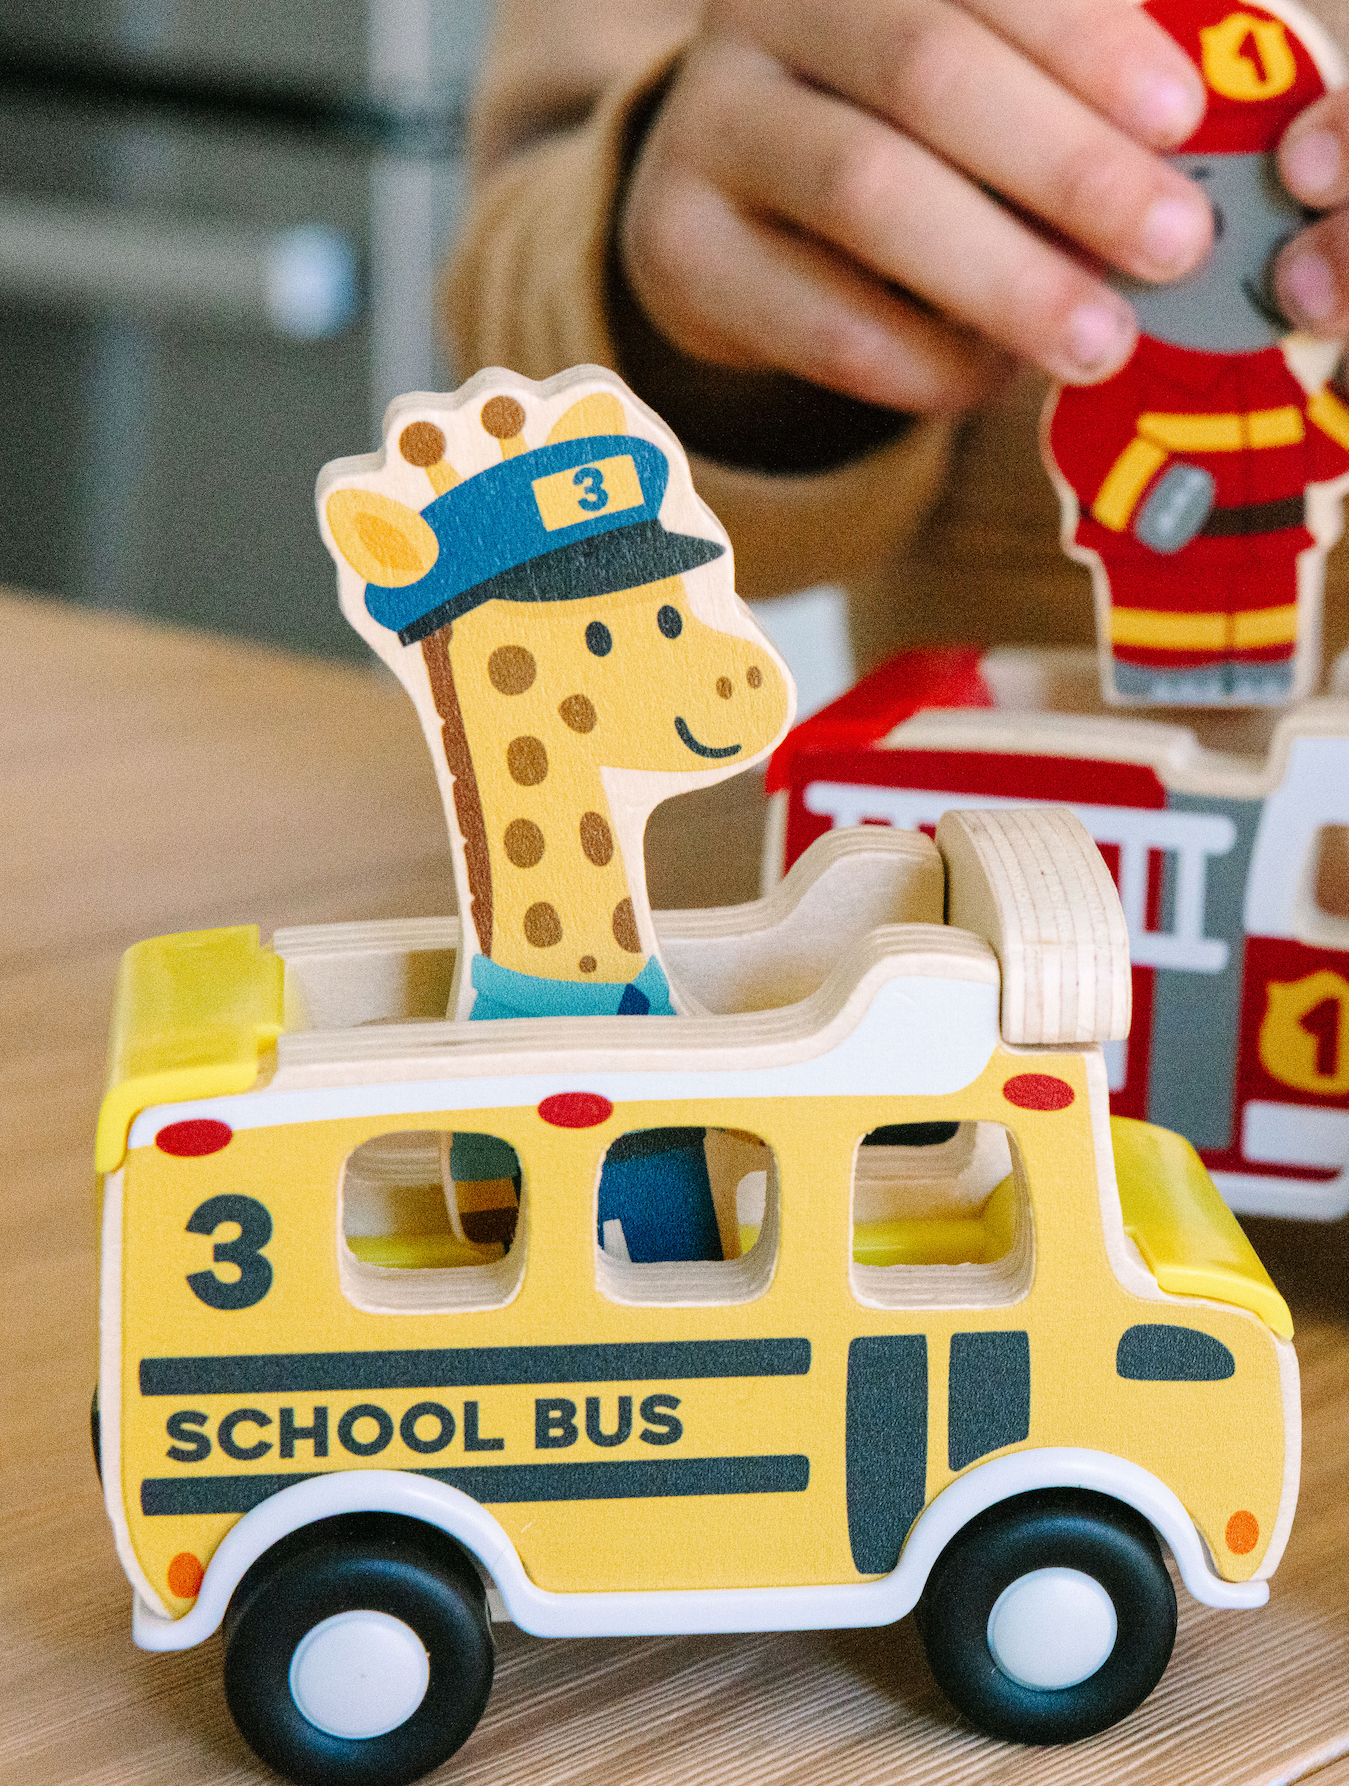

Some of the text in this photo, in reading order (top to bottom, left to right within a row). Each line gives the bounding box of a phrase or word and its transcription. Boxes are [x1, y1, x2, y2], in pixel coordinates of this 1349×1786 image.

[1237, 29, 1269, 85] 1
[572, 467, 609, 511] 3
[1297, 996, 1343, 1080] 1
[185, 1194, 273, 1310] 3
[166, 1394, 683, 1463] SCHOOL BUS
